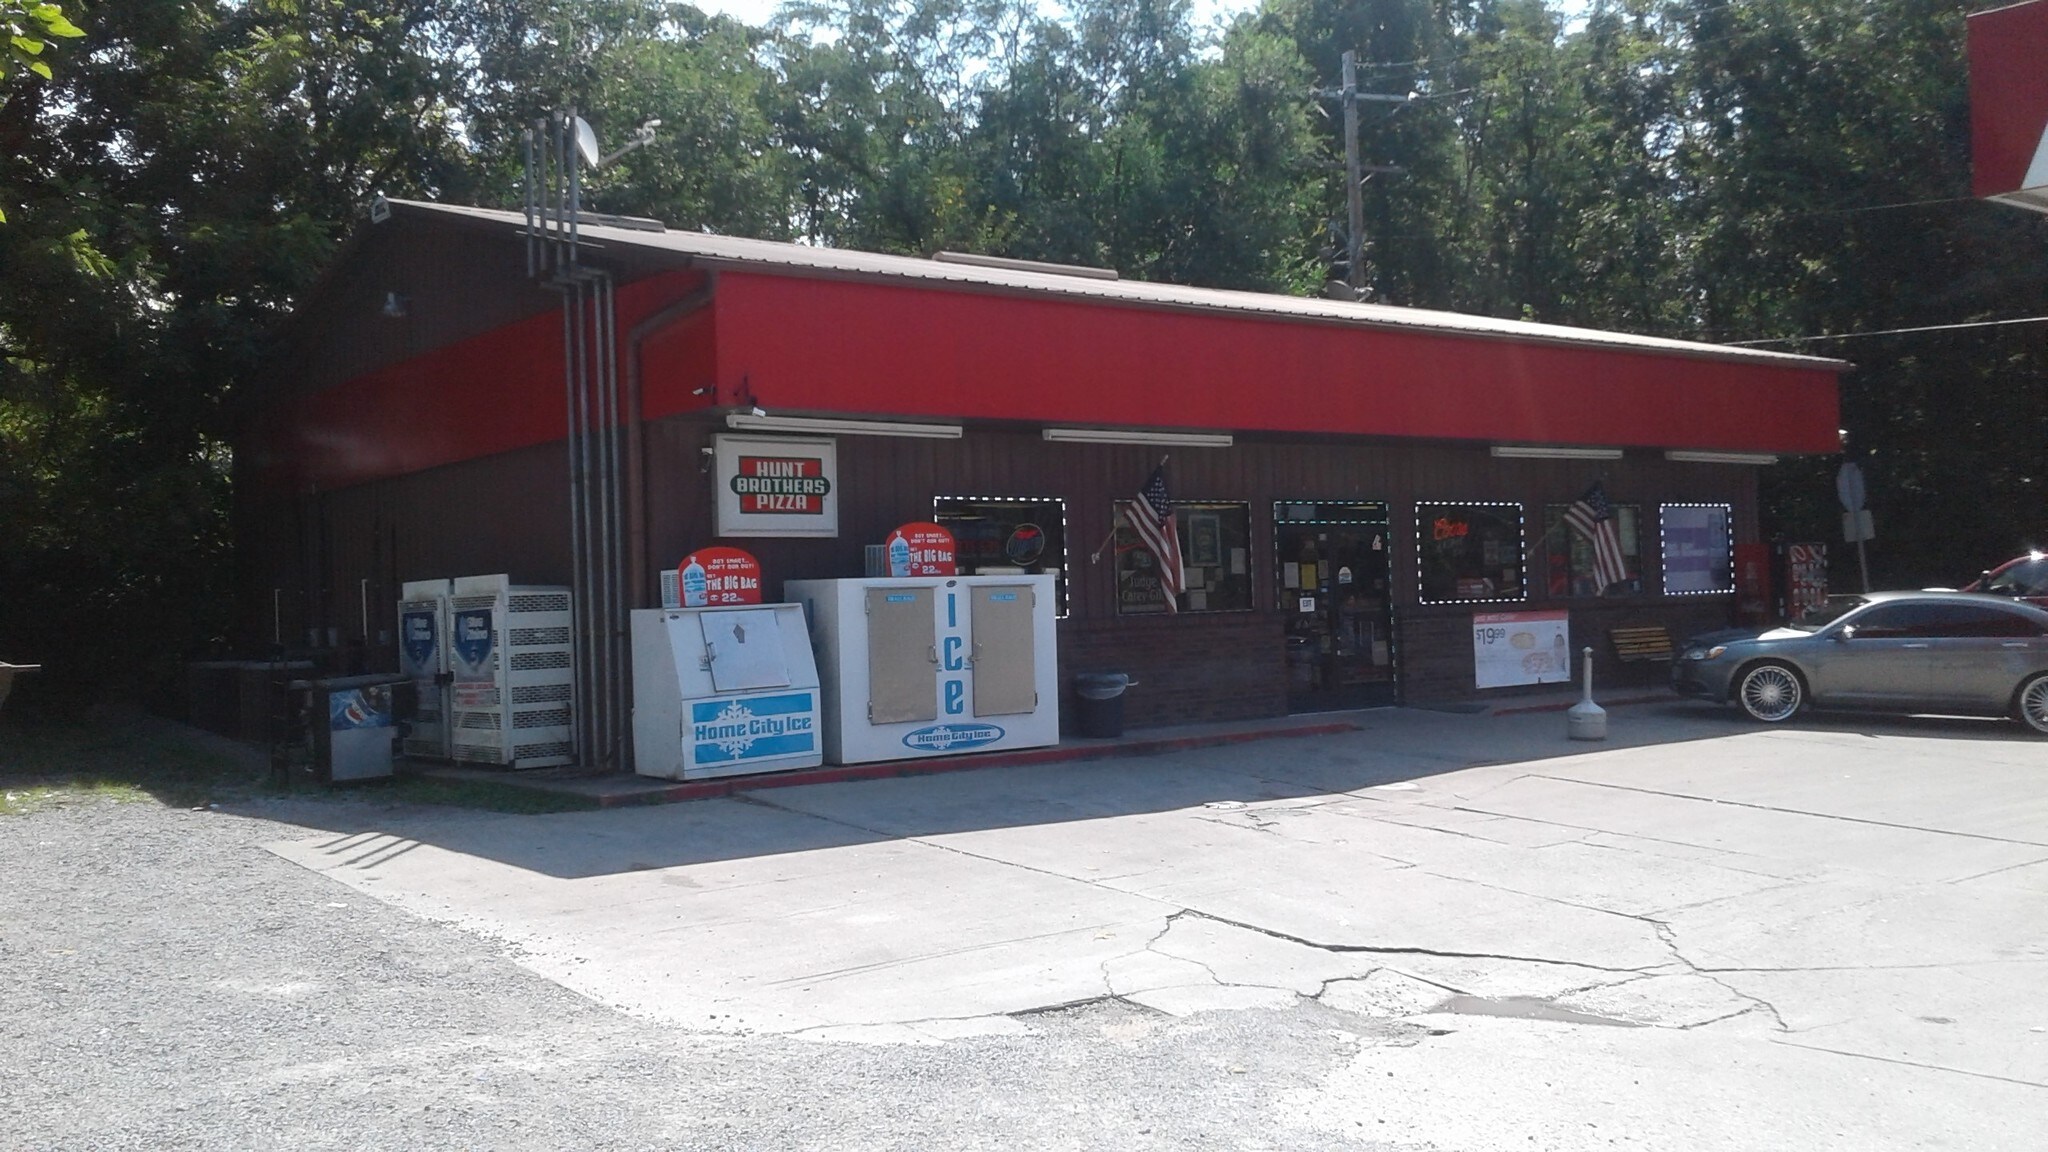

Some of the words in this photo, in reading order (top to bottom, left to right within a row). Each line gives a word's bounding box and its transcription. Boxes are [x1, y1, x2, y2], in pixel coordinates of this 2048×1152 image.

[756, 462, 805, 477] HUNT
[736, 477, 825, 494] BROTHERS
[756, 494, 807, 510] PIZZA
[909, 551, 922, 563] THE
[924, 549, 936, 563] BIG
[937, 550, 952, 562] BAG
[922, 565, 935, 574] 22
[706, 577, 722, 591] THE
[724, 575, 738, 590] BIG
[740, 576, 757, 589] BAG
[721, 592, 737, 602] 22
[695, 723, 747, 741] Home
[750, 717, 784, 736] City
[786, 716, 812, 731] Ice
[917, 733, 950, 743] Home
[951, 731, 973, 741] City
[973, 729, 992, 738] Ice
